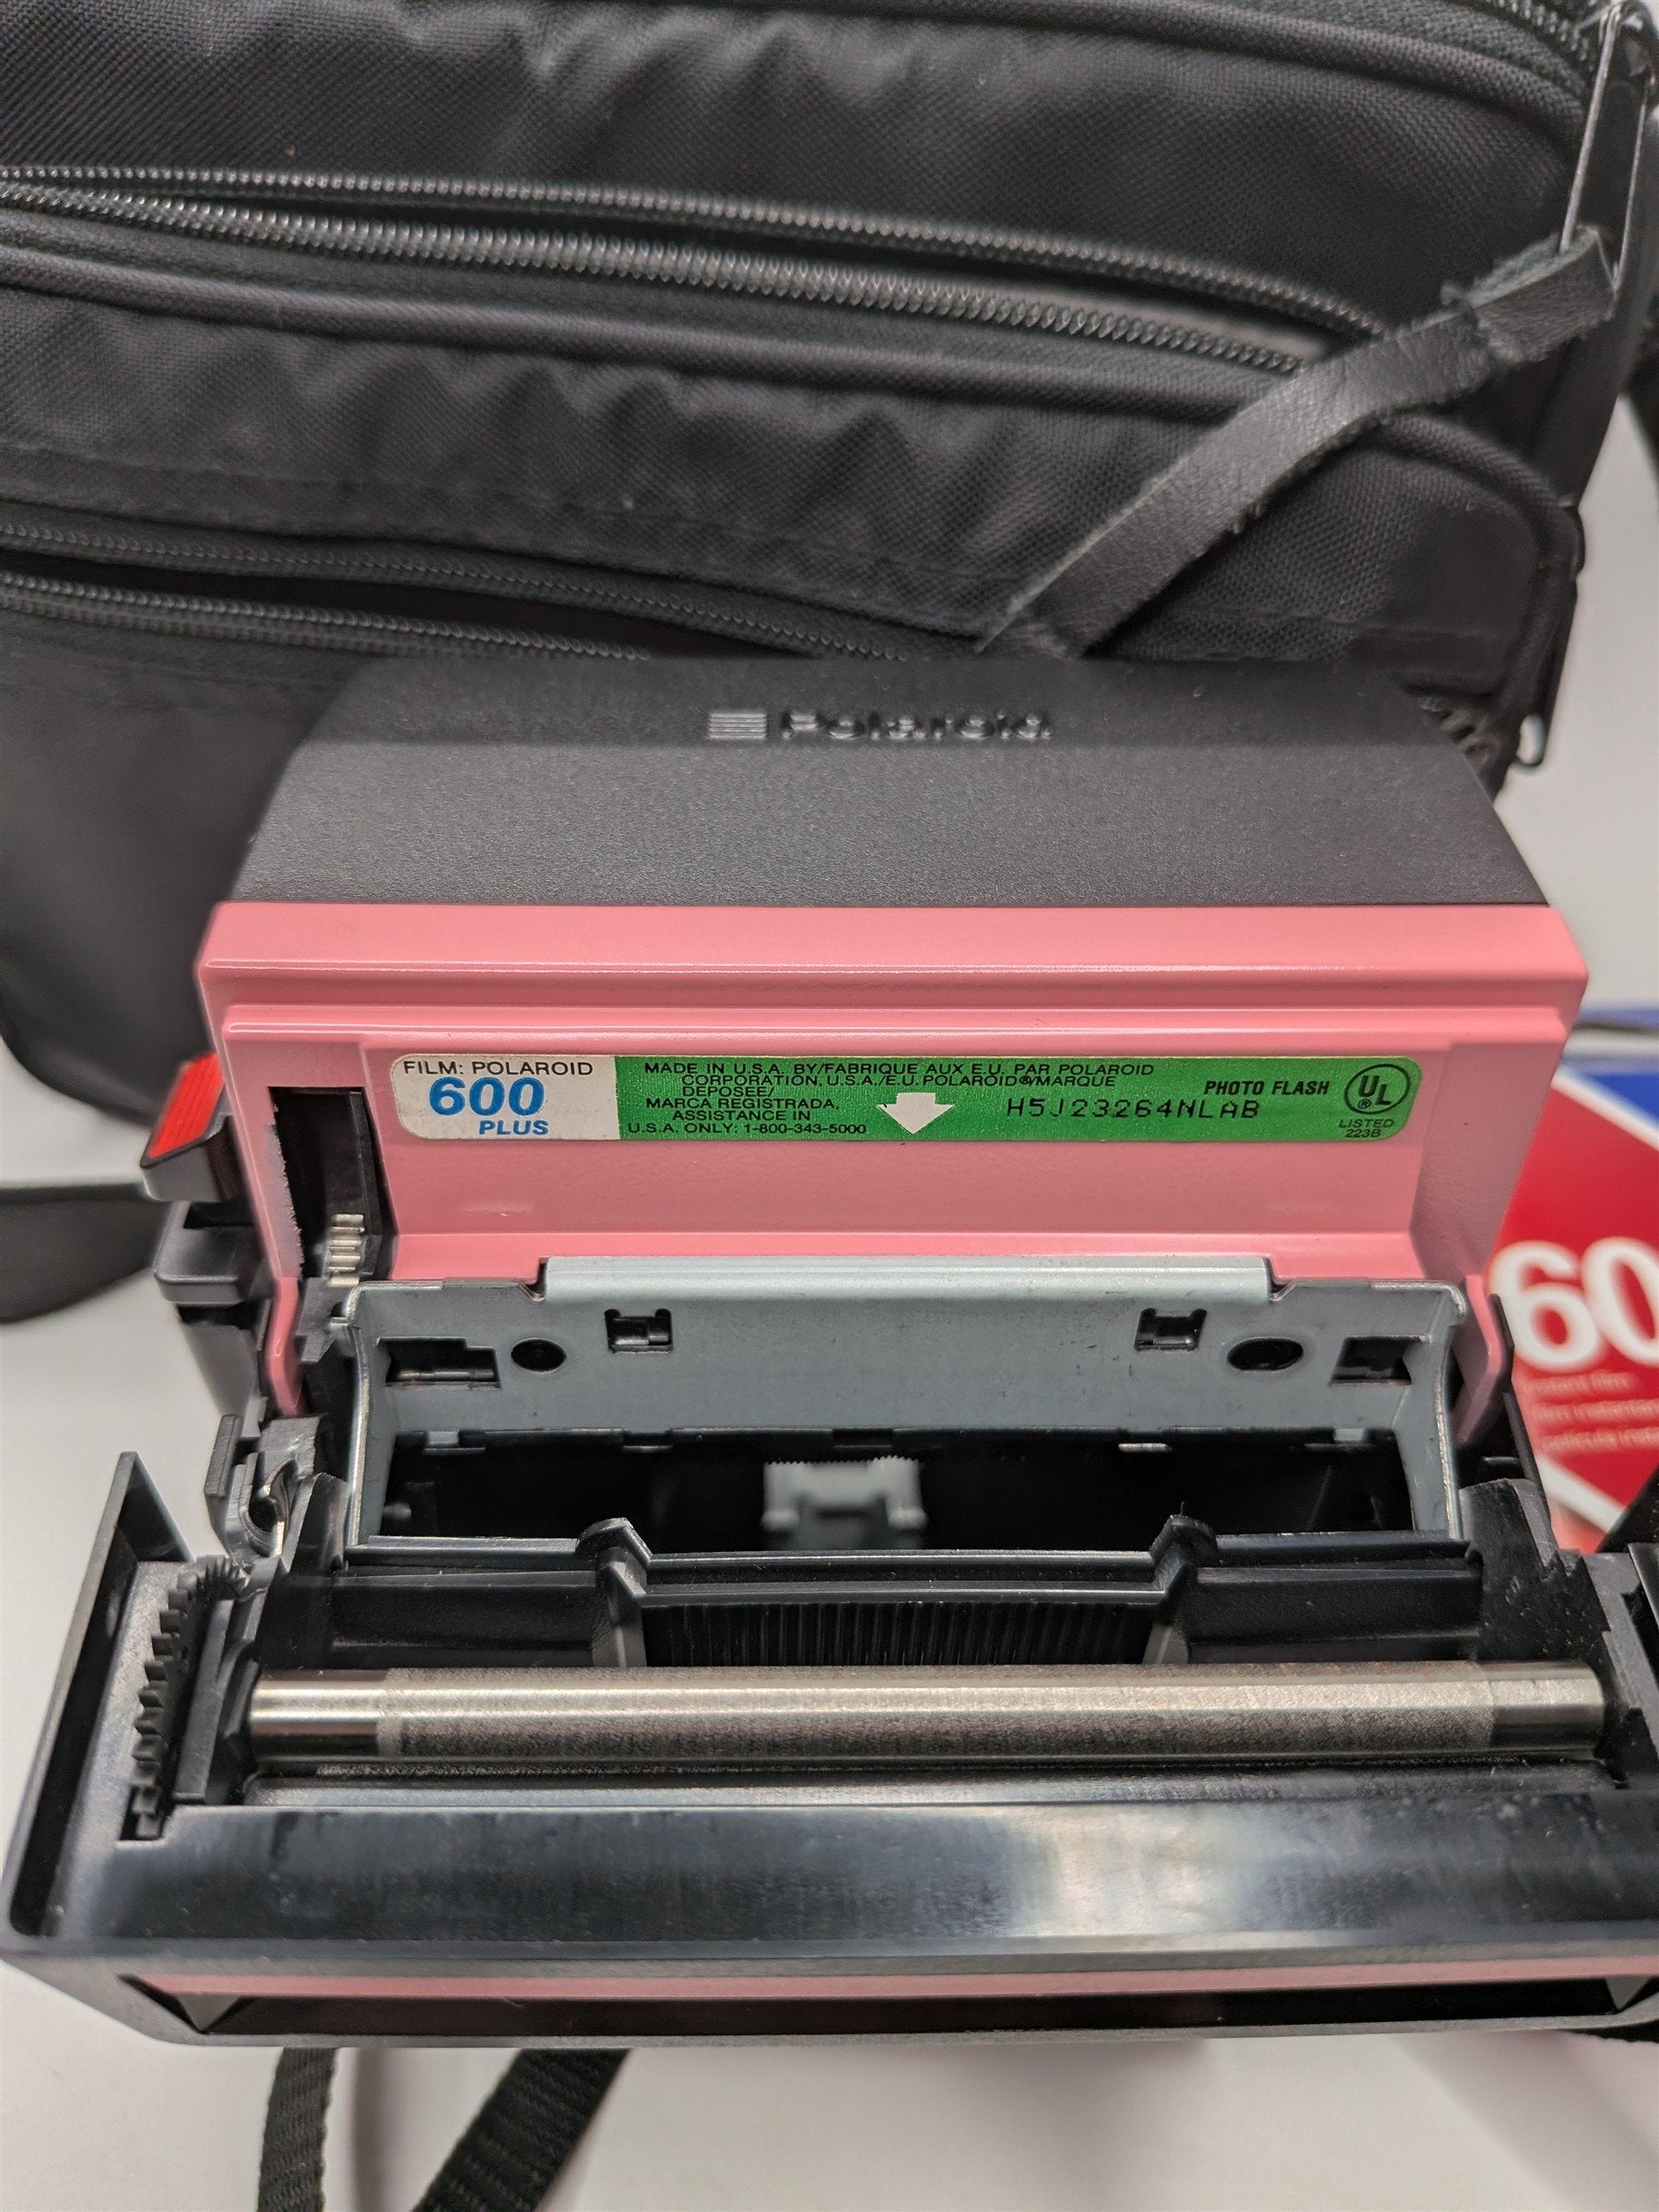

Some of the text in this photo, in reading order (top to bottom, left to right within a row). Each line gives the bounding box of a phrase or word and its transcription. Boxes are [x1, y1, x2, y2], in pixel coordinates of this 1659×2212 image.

[778, 710, 1053, 740] Polaroid
[404, 1061, 594, 1076] FILM: POLAROID
[645, 1063, 1155, 1076] MADE IN U.S.A. BY/FABRIQUE AUX E.U. PAR POLAROID
[682, 1075, 823, 1088] CORPORATION,
[1204, 1080, 1330, 1095] PHOTO FLASH
[429, 1077, 546, 1116] 600
[682, 1087, 775, 1097] DEPOSEE/
[646, 1099, 712, 1109] MARCA
[672, 1111, 811, 1121] ASSISTANCE IN
[478, 1120, 549, 1135] PLUS
[628, 1123, 677, 1134] U.S.A.
[744, 1124, 867, 1134] 1-800-343-5000
[1338, 1118, 1395, 1128] LISTED
